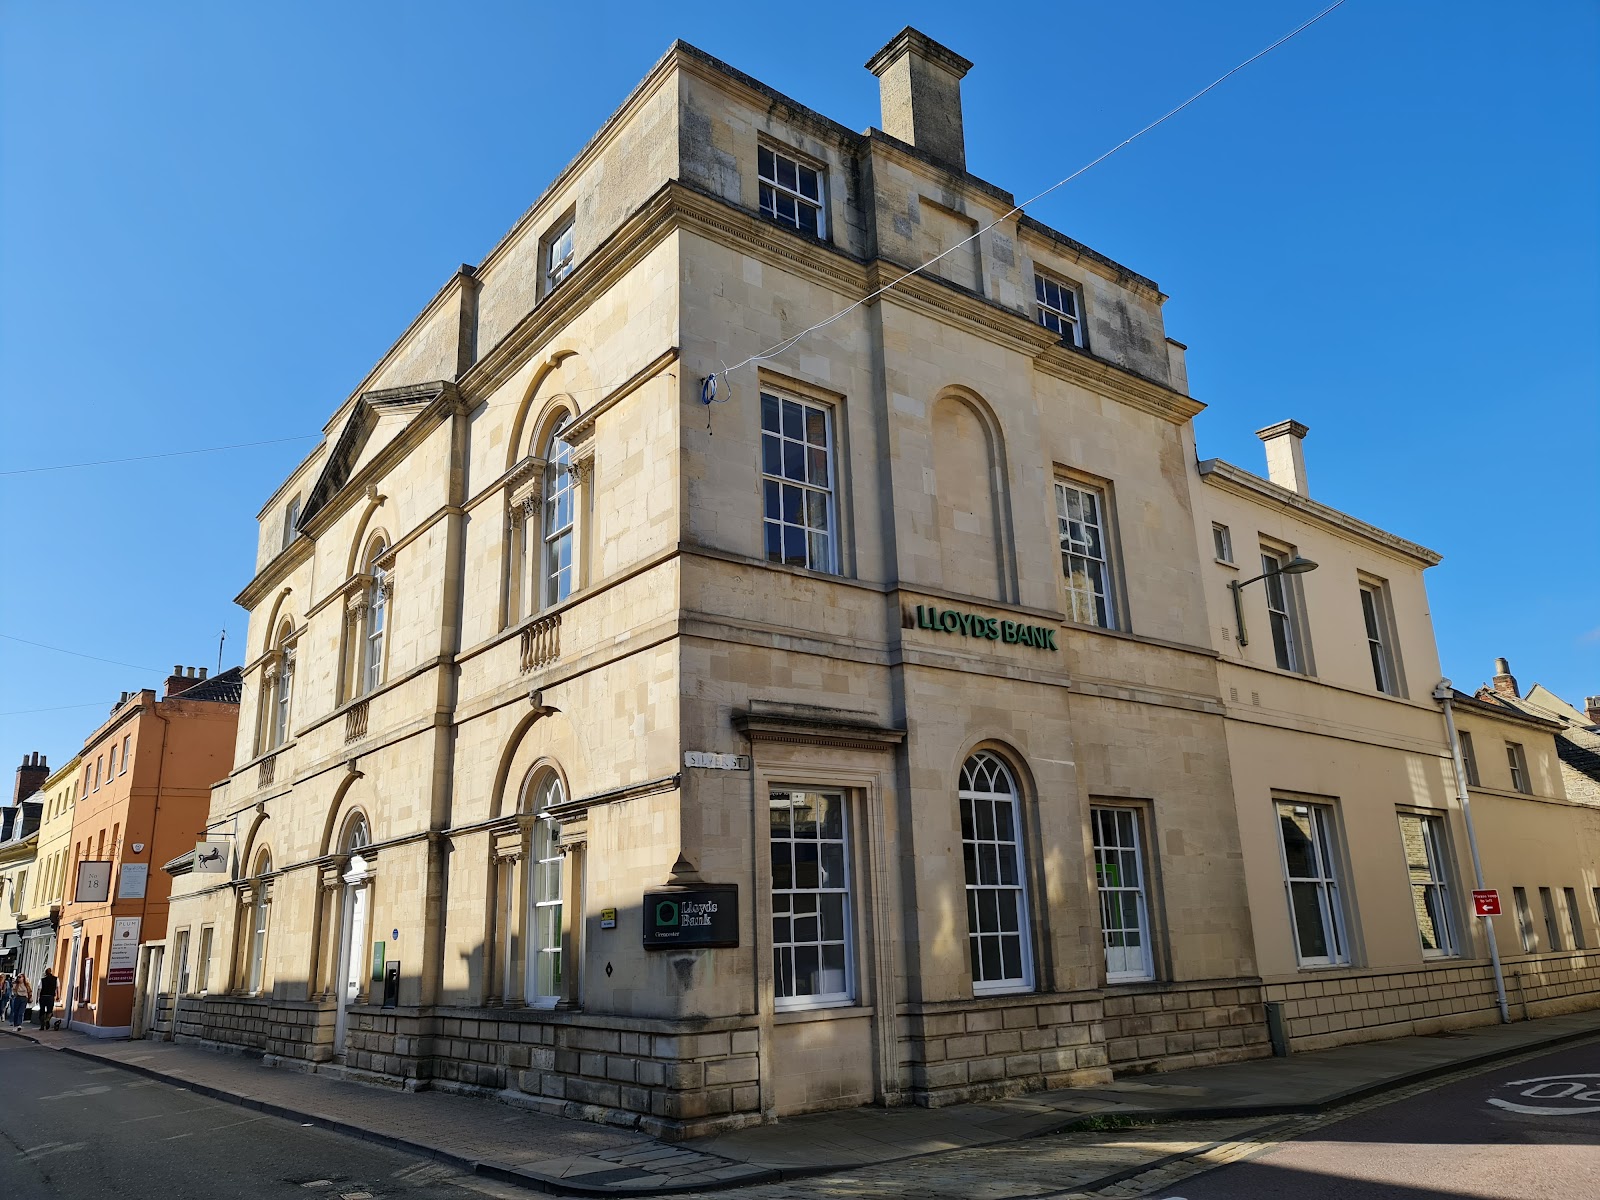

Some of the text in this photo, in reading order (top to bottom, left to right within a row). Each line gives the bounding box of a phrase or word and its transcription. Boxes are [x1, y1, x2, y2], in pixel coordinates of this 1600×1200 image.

[917, 604, 1058, 651] LLOYDS BANK
[690, 754, 729, 767] SILVER
[87, 880, 99, 889] 18
[681, 901, 718, 915] Lloyds
[681, 913, 712, 927] Bank
